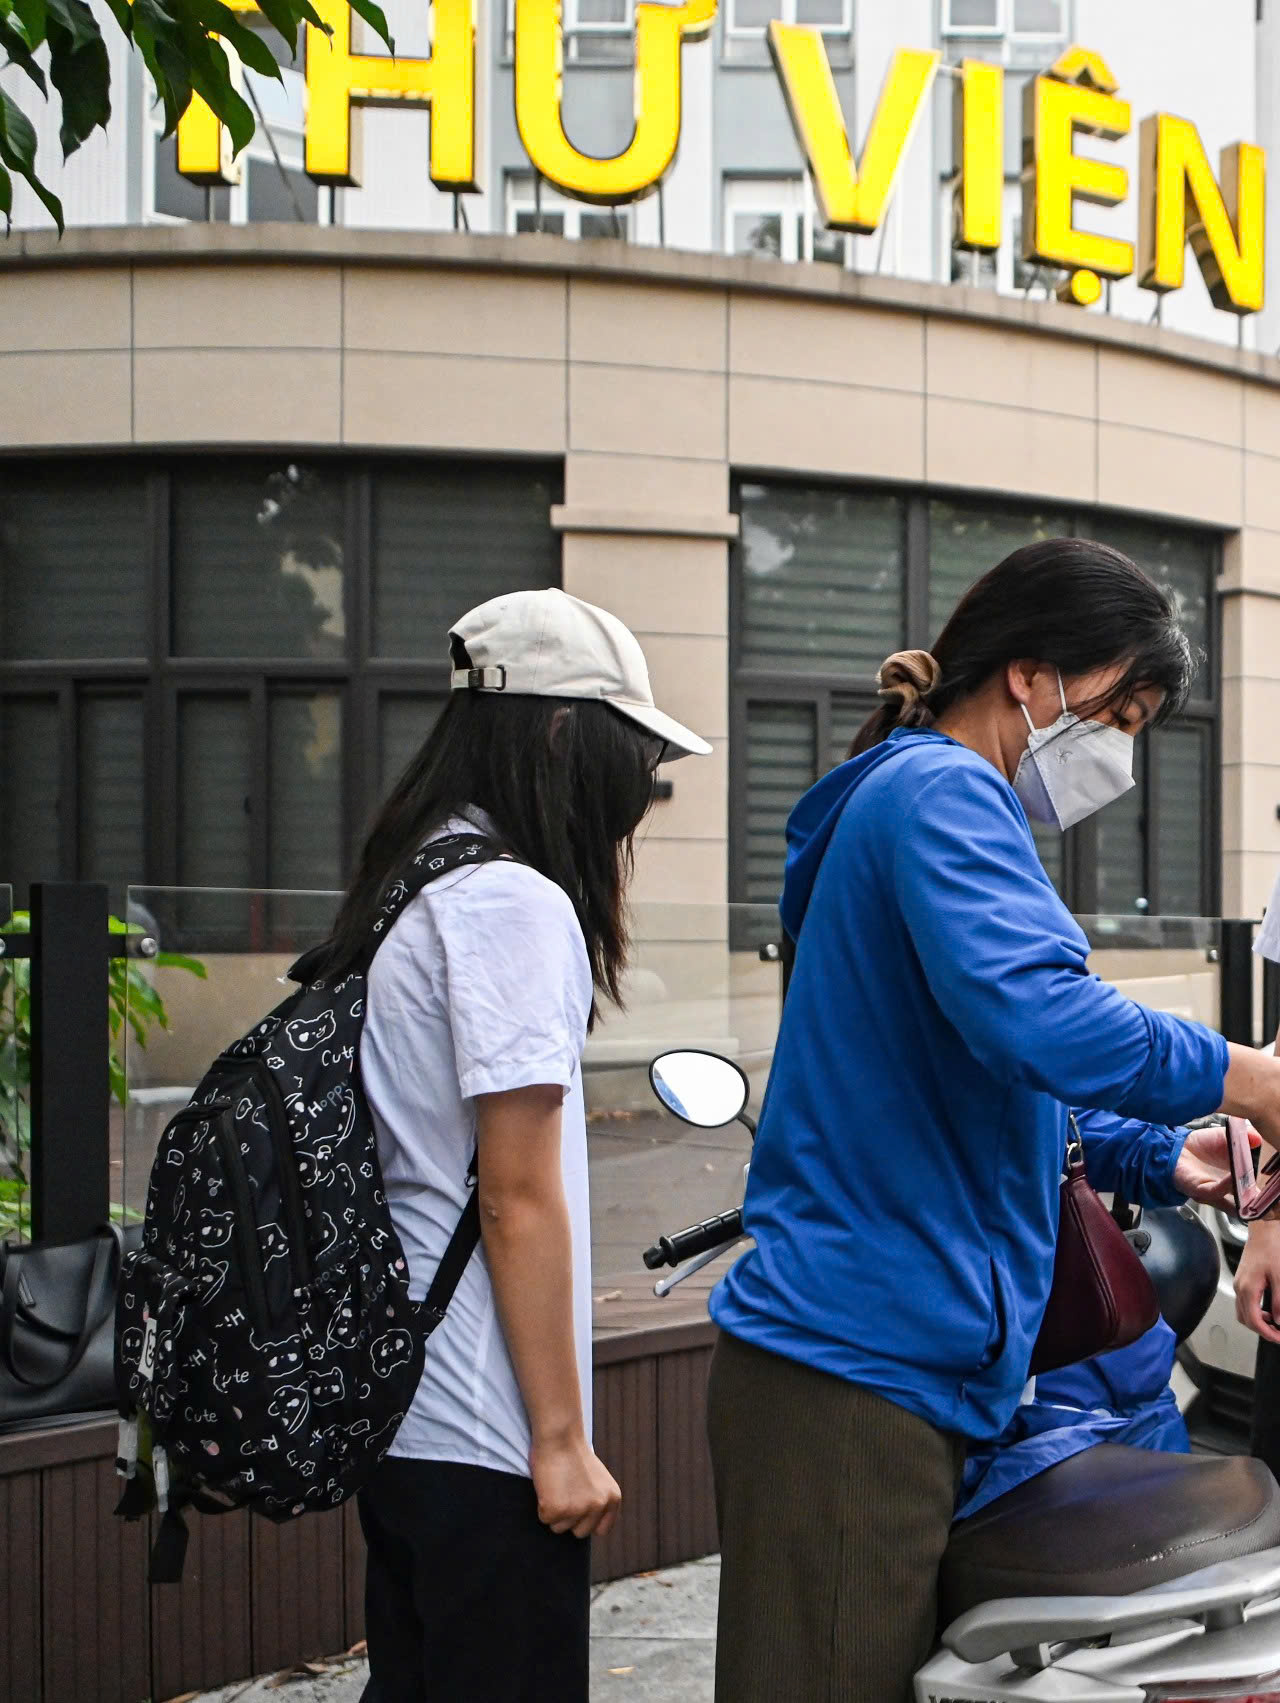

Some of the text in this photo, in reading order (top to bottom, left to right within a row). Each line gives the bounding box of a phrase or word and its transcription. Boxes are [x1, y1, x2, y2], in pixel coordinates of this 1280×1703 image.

[768, 19, 1266, 314] VIỆN
[322, 1045, 355, 1067] Cute
[184, 1406, 219, 1423] Cute
